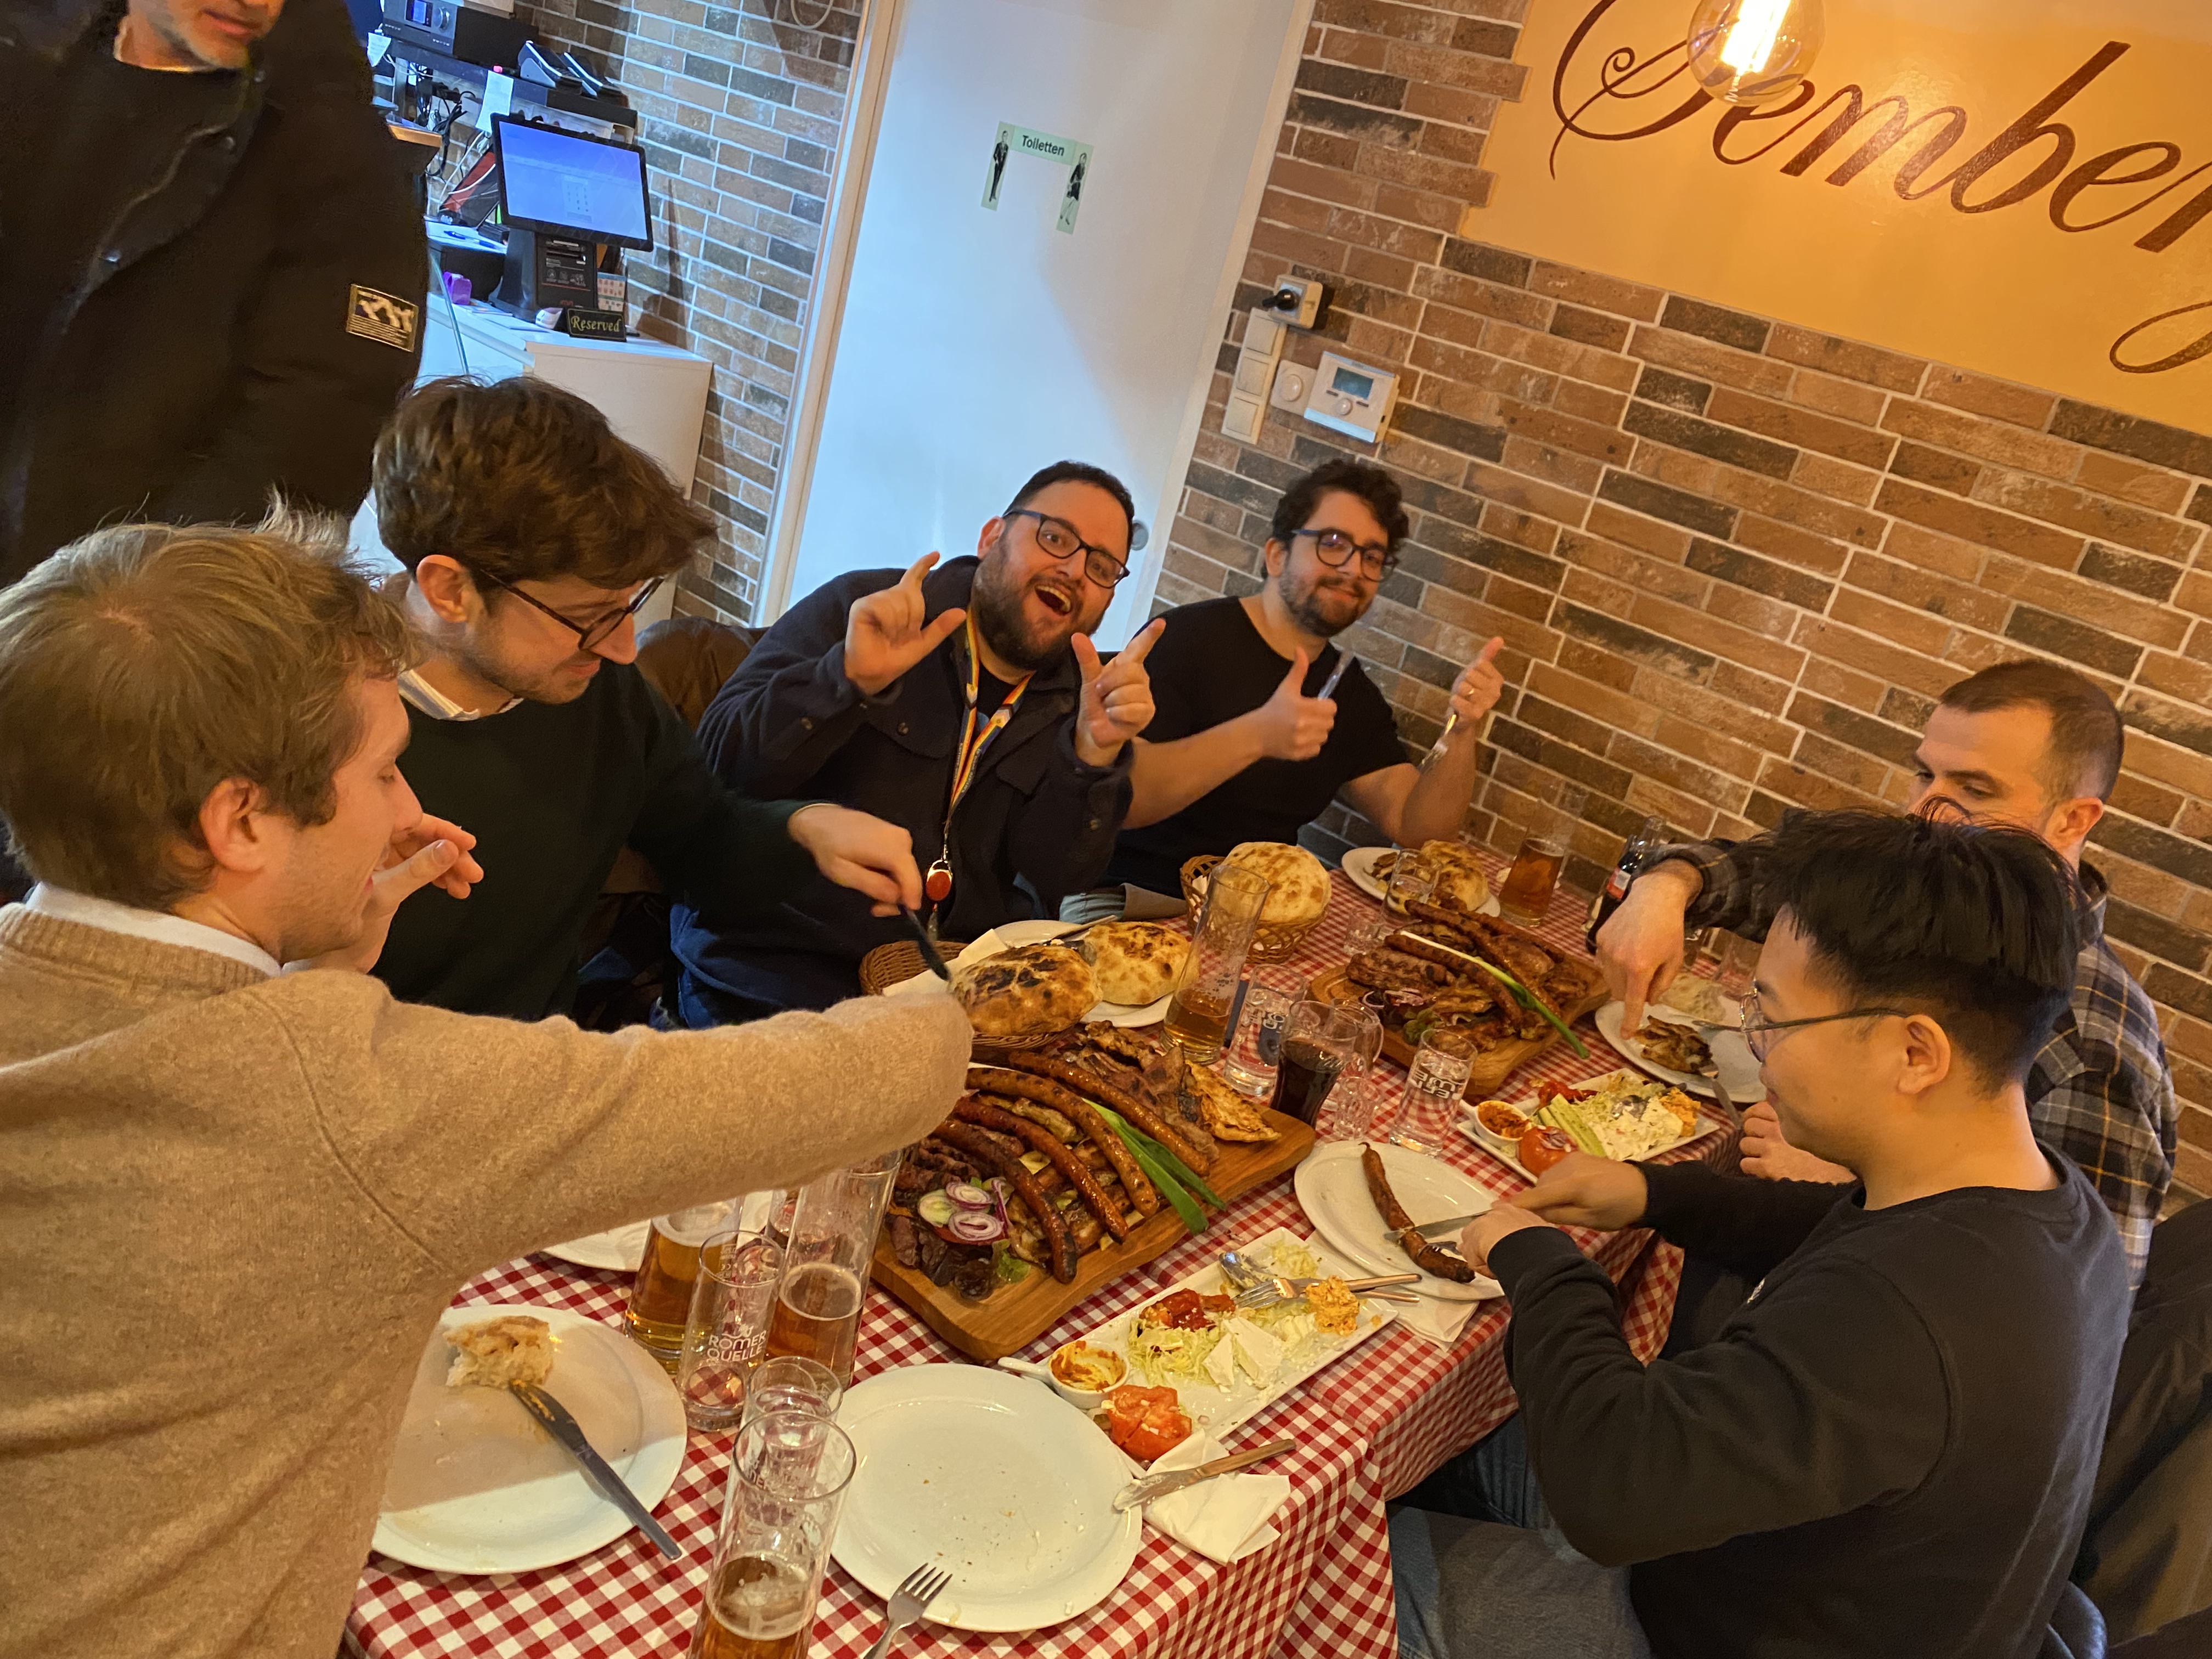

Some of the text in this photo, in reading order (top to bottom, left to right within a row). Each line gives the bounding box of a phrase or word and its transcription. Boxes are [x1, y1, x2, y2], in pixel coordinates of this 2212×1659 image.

[1022, 134, 1065, 156] Toiletten
[571, 315, 622, 332] Reserved
[706, 1340, 765, 1363] QUELLE
